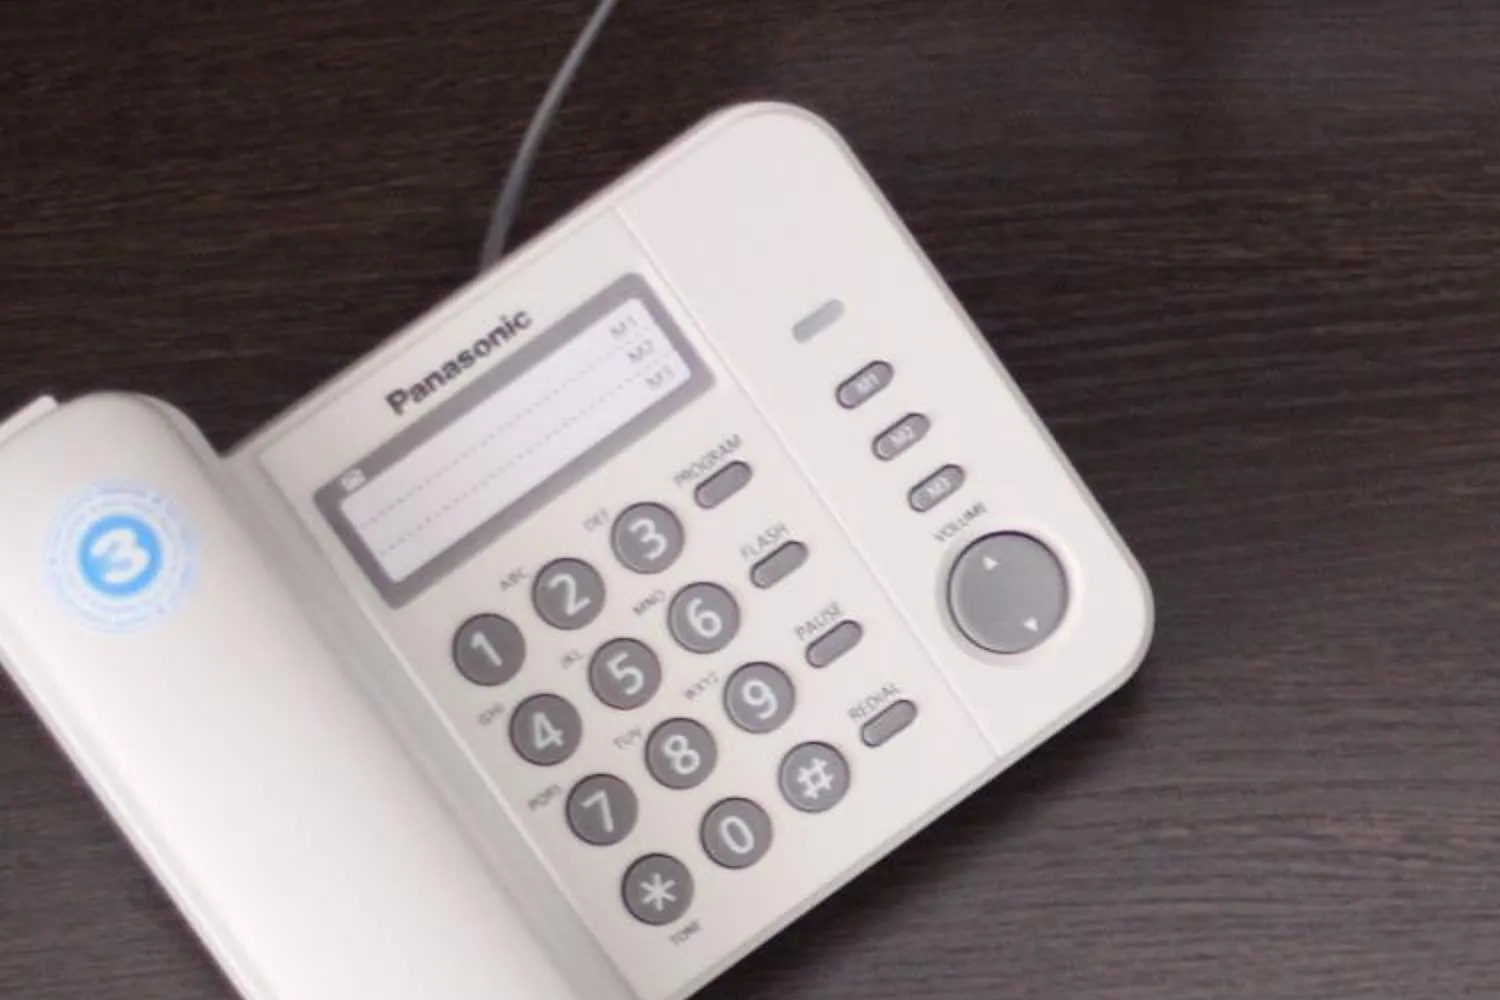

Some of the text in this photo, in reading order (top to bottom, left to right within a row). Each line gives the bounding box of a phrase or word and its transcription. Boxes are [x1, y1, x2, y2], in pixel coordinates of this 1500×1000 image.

[609, 316, 638, 342] M1
[385, 309, 534, 416] Panasonic
[627, 339, 655, 364] M2
[672, 434, 742, 486] PROGRAM
[630, 518, 667, 560] 3
[739, 523, 788, 561] FLASH
[934, 501, 987, 544] VOLUME
[90, 527, 147, 584] 3
[548, 573, 591, 615] 2
[631, 588, 667, 617] MNO
[686, 599, 723, 638] 6
[794, 601, 843, 641] PAUSE
[470, 630, 504, 667] 1
[607, 652, 644, 694] 5
[740, 680, 777, 719] 9
[847, 682, 901, 723] REDIAL
[532, 711, 565, 751] 4
[662, 735, 701, 775] 8
[796, 756, 835, 799] #
[583, 790, 614, 832] 7
[720, 815, 754, 854] 0
[668, 920, 703, 947] TONE
